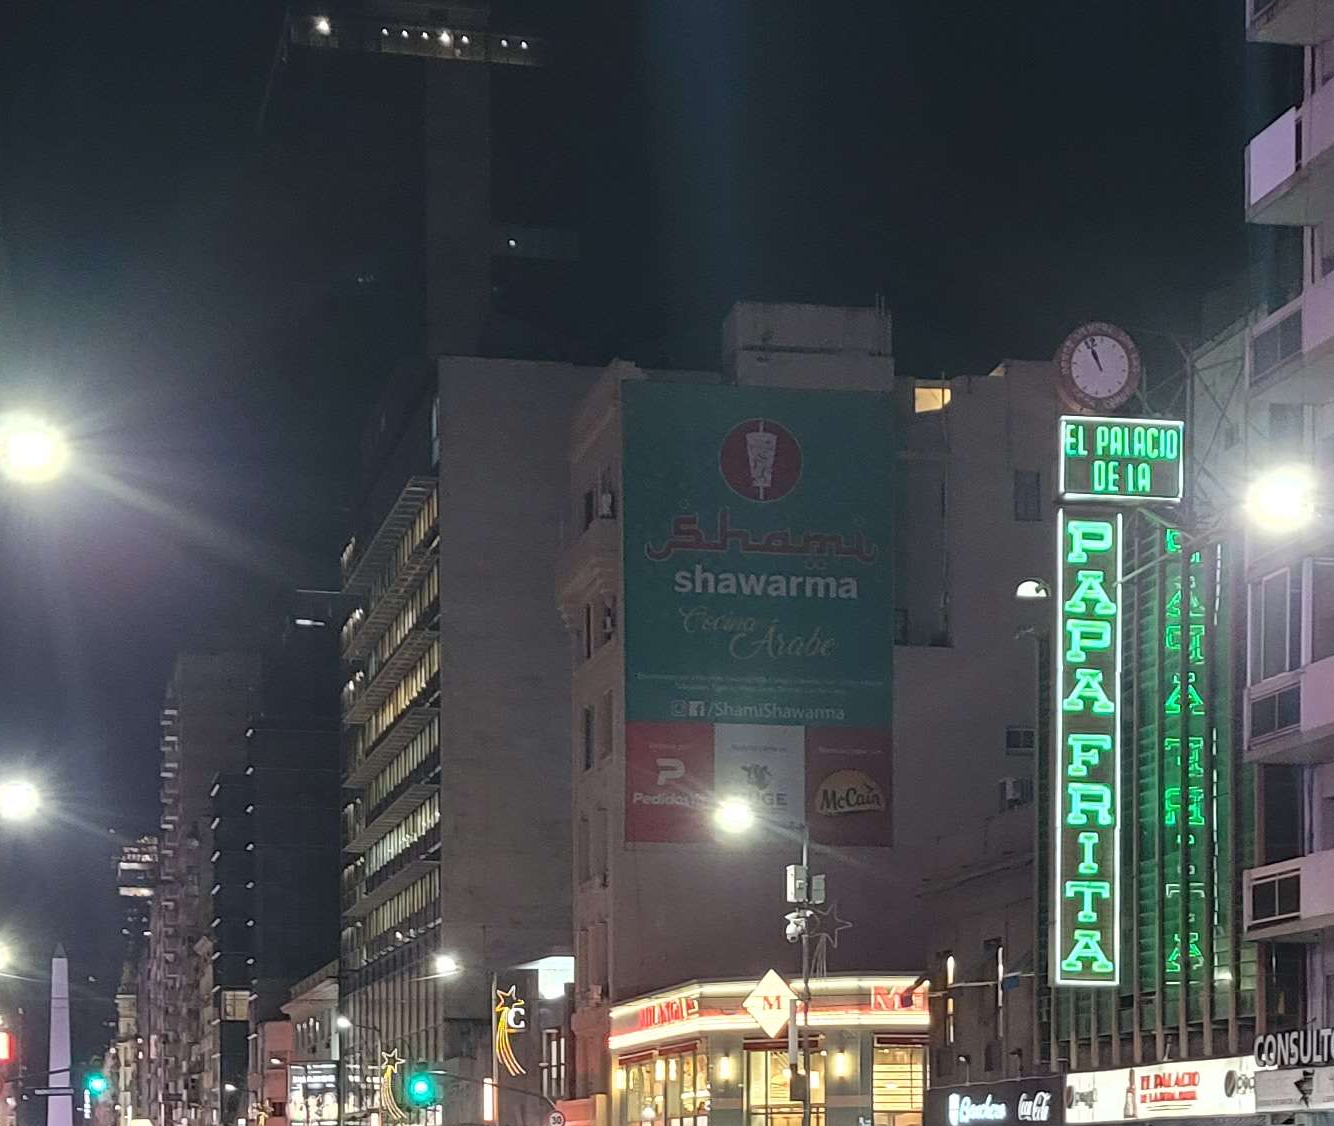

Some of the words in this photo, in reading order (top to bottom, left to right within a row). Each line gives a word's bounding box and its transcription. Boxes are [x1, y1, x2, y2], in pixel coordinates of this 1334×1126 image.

[1065, 424, 1089, 457] EL
[1096, 425, 1178, 460] PALACIO
[1093, 460, 1120, 493] DE
[1127, 462, 1151, 493] LA
[673, 564, 859, 600] shawarma
[678, 606, 758, 634] Cocina
[1063, 519, 1117, 713] PAPA
[819, 785, 882, 811] McCain
[1062, 734, 1115, 974] FRITA
[550, 1115, 562, 1125] 30
